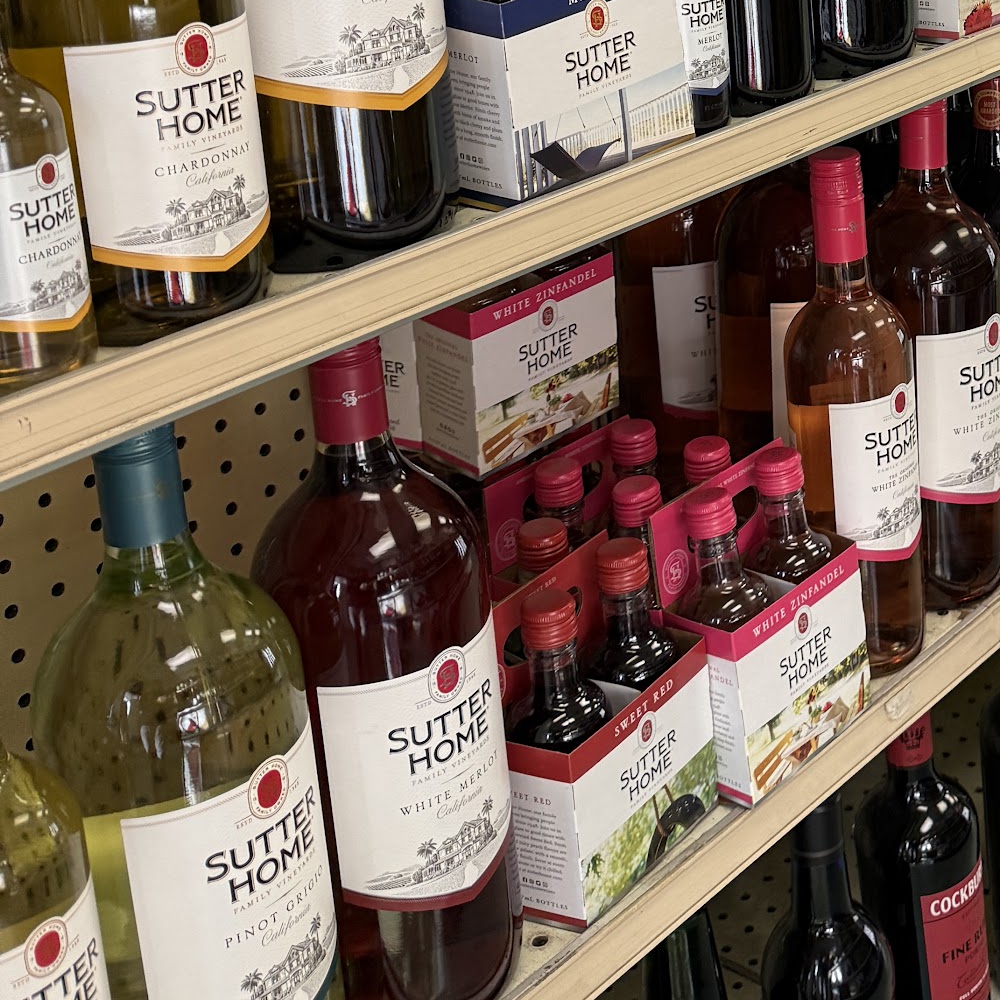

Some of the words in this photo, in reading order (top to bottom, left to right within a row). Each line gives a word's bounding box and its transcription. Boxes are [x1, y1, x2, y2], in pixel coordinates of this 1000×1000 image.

[690, 8, 724, 28] HOME
[565, 30, 637, 73] SUTTER
[698, 32, 722, 46] MERLOT
[576, 51, 632, 90] HOME
[135, 69, 246, 118] SUTTER
[156, 95, 244, 142] HOME
[154, 140, 250, 178] CHARDONNAY
[185, 166, 235, 188] California
[10, 182, 76, 222] SUTTER
[472, 177, 503, 190] BOTTLES
[24, 204, 76, 238] HOME
[492, 297, 532, 320] WHITE
[535, 268, 597, 301] ZINFANDEL
[518, 323, 578, 363] SUTTER
[527, 340, 573, 375] HOME
[865, 414, 916, 451] SUTTE
[953, 421, 985, 437] WHITE
[871, 479, 898, 493] WHITE
[752, 606, 787, 639] WHITE
[790, 564, 845, 608] ZINFANDEL
[779, 625, 832, 678] SUTTER
[788, 646, 829, 690] HOME
[388, 678, 493, 756] SUTTER
[613, 699, 649, 738] SWEET
[653, 678, 674, 704] RED
[408, 710, 489, 777] HOME
[620, 729, 677, 792] SUTTER
[400, 789, 453, 817] WHITE
[459, 750, 498, 793] MERLOT
[629, 749, 673, 801] HOME
[436, 785, 483, 820] California
[533, 796, 552, 806] RED
[204, 786, 316, 884] SUTTER
[228, 815, 315, 905] HOME
[225, 911, 279, 949] PINOT
[286, 865, 323, 913] GRIGIO
[233, 887, 273, 915] FAMILY
[535, 897, 568, 910] BOTTLES
[261, 902, 311, 947] California
[942, 940, 972, 964] FINE
